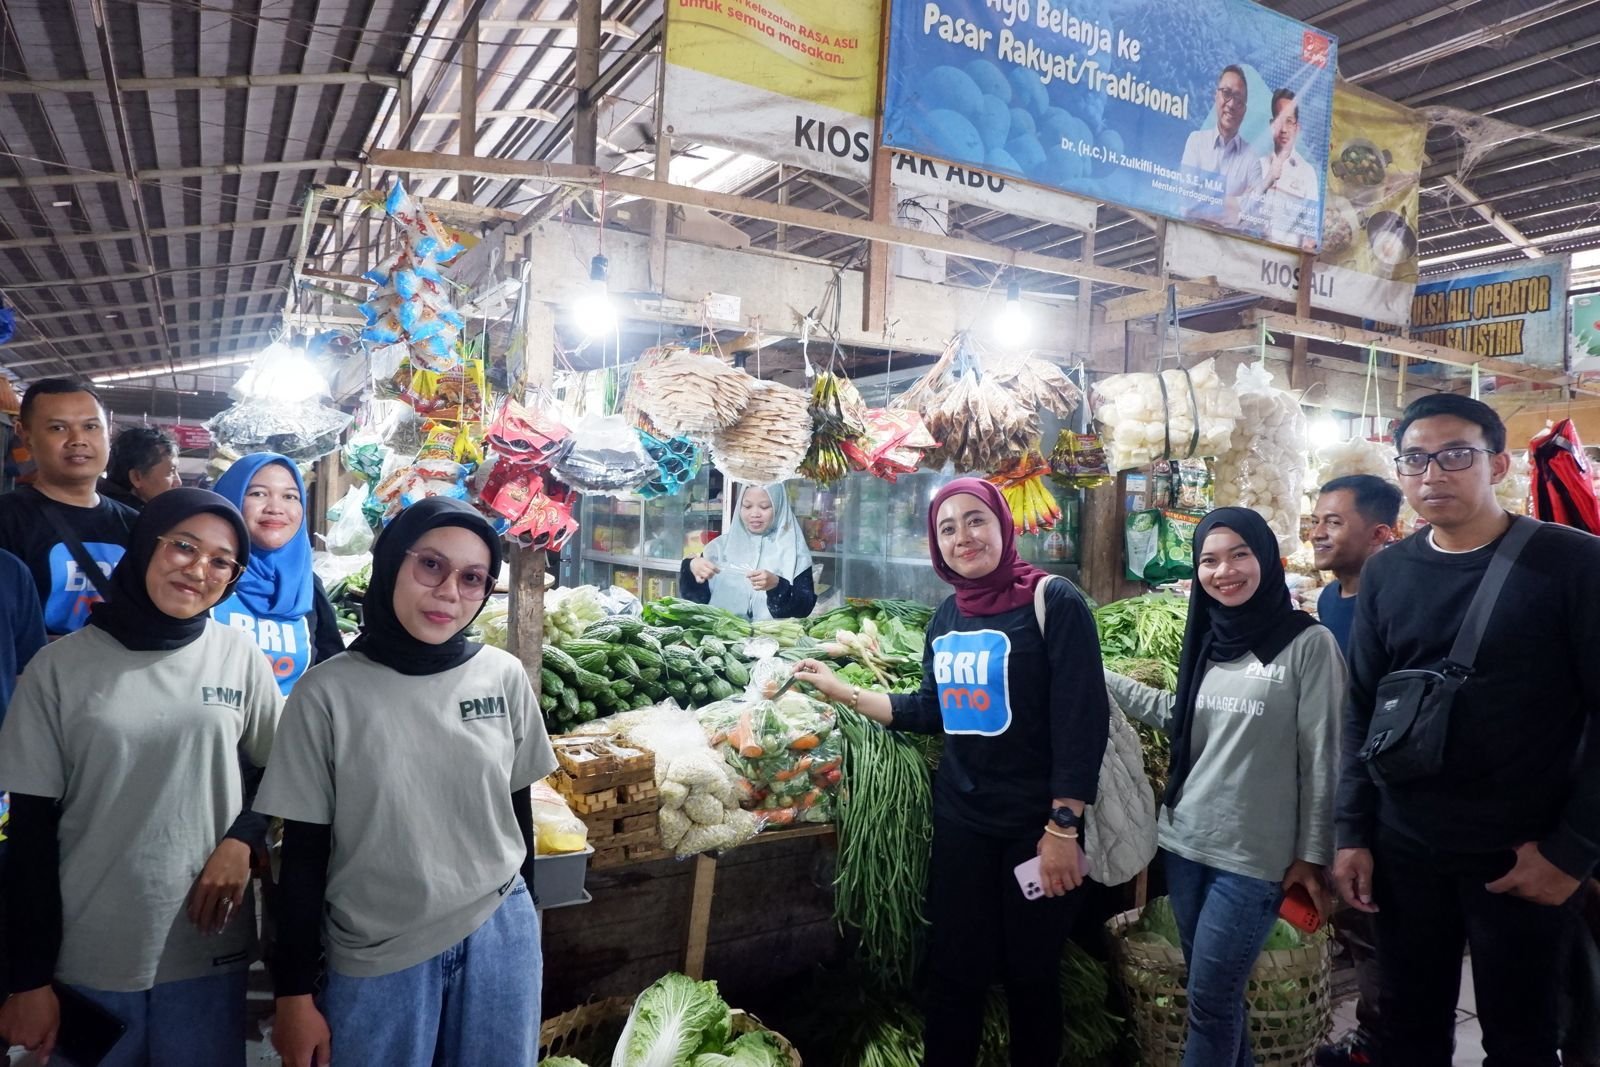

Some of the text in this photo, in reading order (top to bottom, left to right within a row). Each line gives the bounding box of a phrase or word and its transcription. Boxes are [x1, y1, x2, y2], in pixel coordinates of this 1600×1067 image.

[680, 0, 845, 64] untuk semua masakan.
[745, 0, 859, 49] kelezatan RASA ASLI
[1037, 0, 1112, 56] Belanja
[1117, 29, 1141, 62] ke
[923, 3, 1189, 120] Pasar Rakyat/Tradisional
[795, 115, 869, 163] KIOS
[892, 151, 938, 179] AK
[1061, 137, 1077, 152] Dr.
[1078, 139, 1107, 163] (H.C.)
[1109, 154, 1119, 164] H.
[1120, 155, 1153, 173] Zulkifli
[1204, 179, 1225, 193] M.M.
[1152, 179, 1224, 206] Menteri Perdagangan
[1261, 258, 1300, 290] KIOS
[1411, 291, 1447, 328] ULSA
[1447, 286, 1472, 323] ALL
[1473, 275, 1552, 320] OPERATOR
[1465, 318, 1525, 358] LISTRIK
[229, 612, 297, 654] BRI
[934, 650, 991, 685] BRI
[1244, 662, 1286, 681] PNM
[202, 686, 242, 707] PNM
[459, 696, 506, 719] PNM
[942, 687, 991, 711] mo
[1206, 695, 1265, 716] MAGELANG
